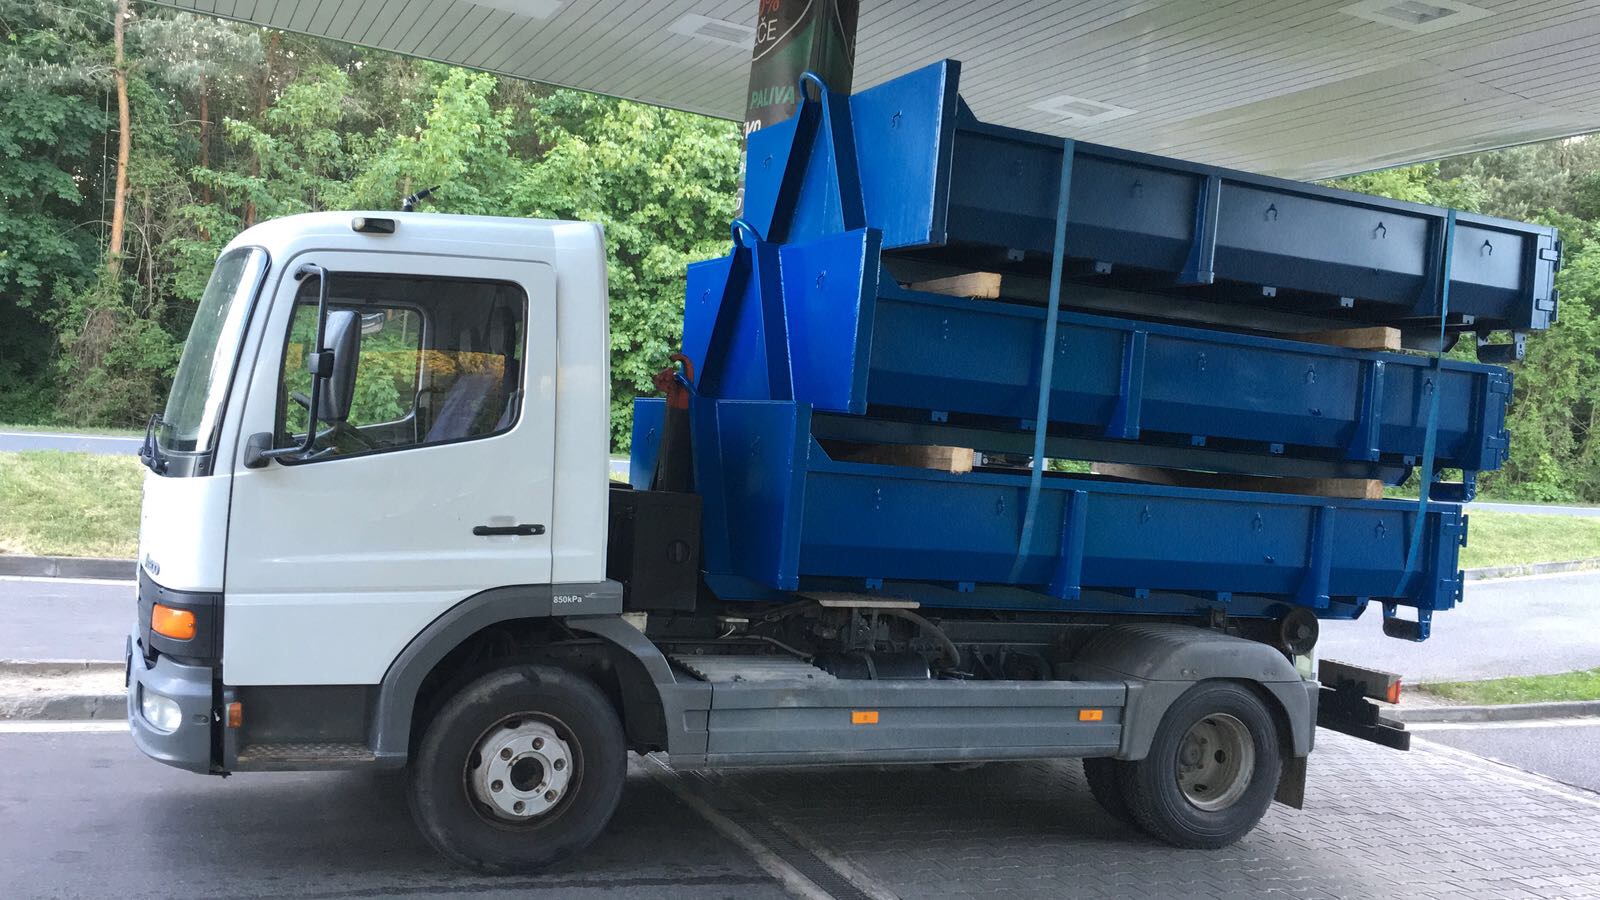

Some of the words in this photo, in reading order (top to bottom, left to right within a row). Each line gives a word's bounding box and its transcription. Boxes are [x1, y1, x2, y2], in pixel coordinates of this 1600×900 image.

[754, 16, 778, 46] ČE
[750, 86, 795, 110] PALIVA
[553, 595, 582, 604] 850kPa
